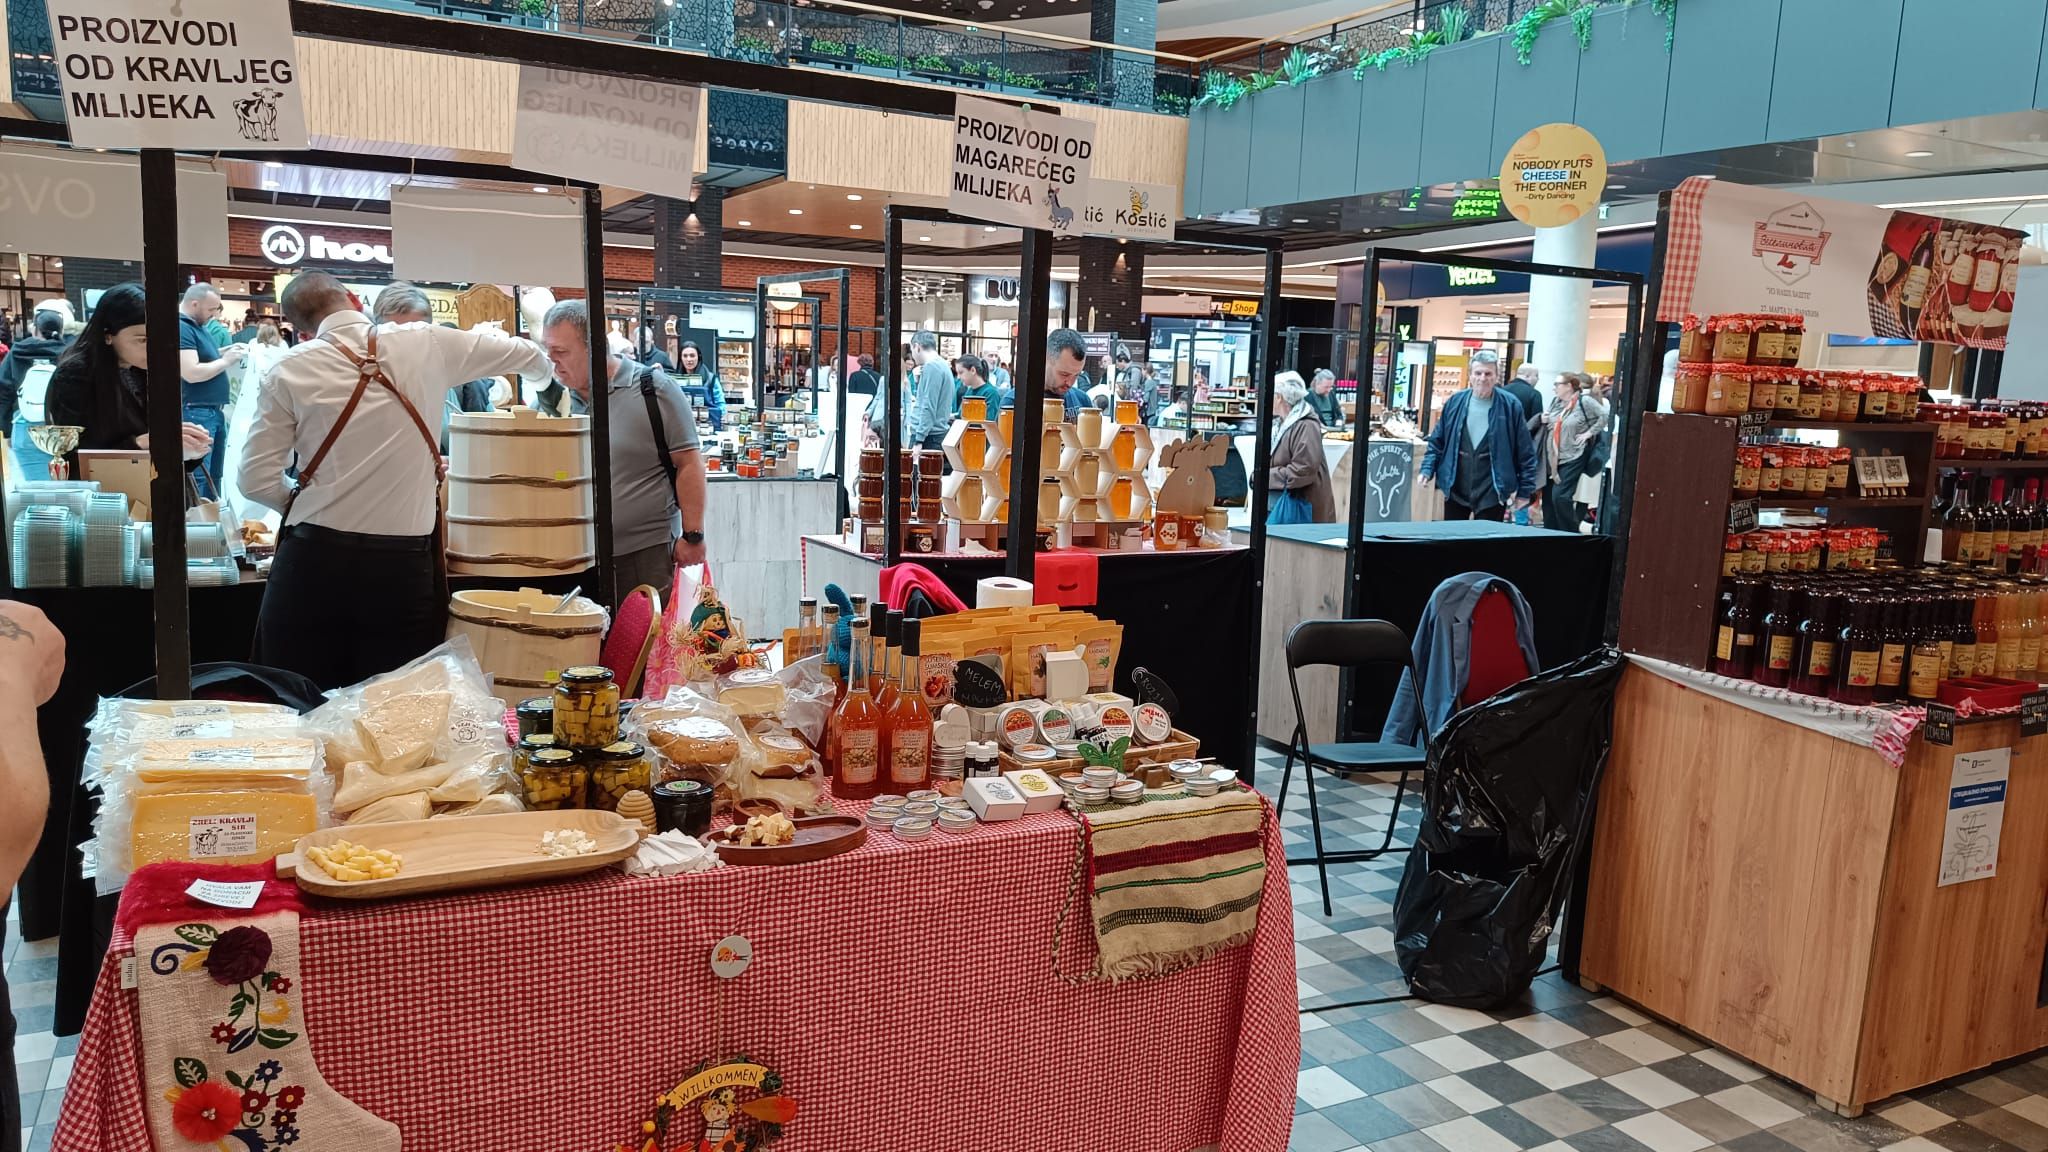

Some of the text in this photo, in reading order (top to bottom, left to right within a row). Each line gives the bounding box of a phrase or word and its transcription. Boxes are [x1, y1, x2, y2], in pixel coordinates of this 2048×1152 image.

[58, 15, 238, 47] PROIZVODI
[65, 53, 114, 80] OD
[124, 56, 293, 84] KRAVLJEG
[71, 92, 216, 119] MLIJEKA
[957, 115, 1092, 160] PROIZVODI OD
[955, 143, 1076, 184] MAGAREĆEG
[1512, 158, 1593, 170] NOBODY PUTS
[1522, 170, 1580, 181] CHEESE IN
[954, 171, 1032, 205] MLIJEKA
[1514, 181, 1587, 192] THE CORNER
[1547, 192, 1575, 200] Dancing
[1116, 208, 1167, 229] Kostić
[1234, 303, 1255, 313] Shop
[1380, 445, 1402, 455] SPIRIT
[965, 667, 1001, 694] MELEM
[219, 816, 254, 824] KRAVLJI
[679, 1069, 758, 1102] WILLKOMMEN
